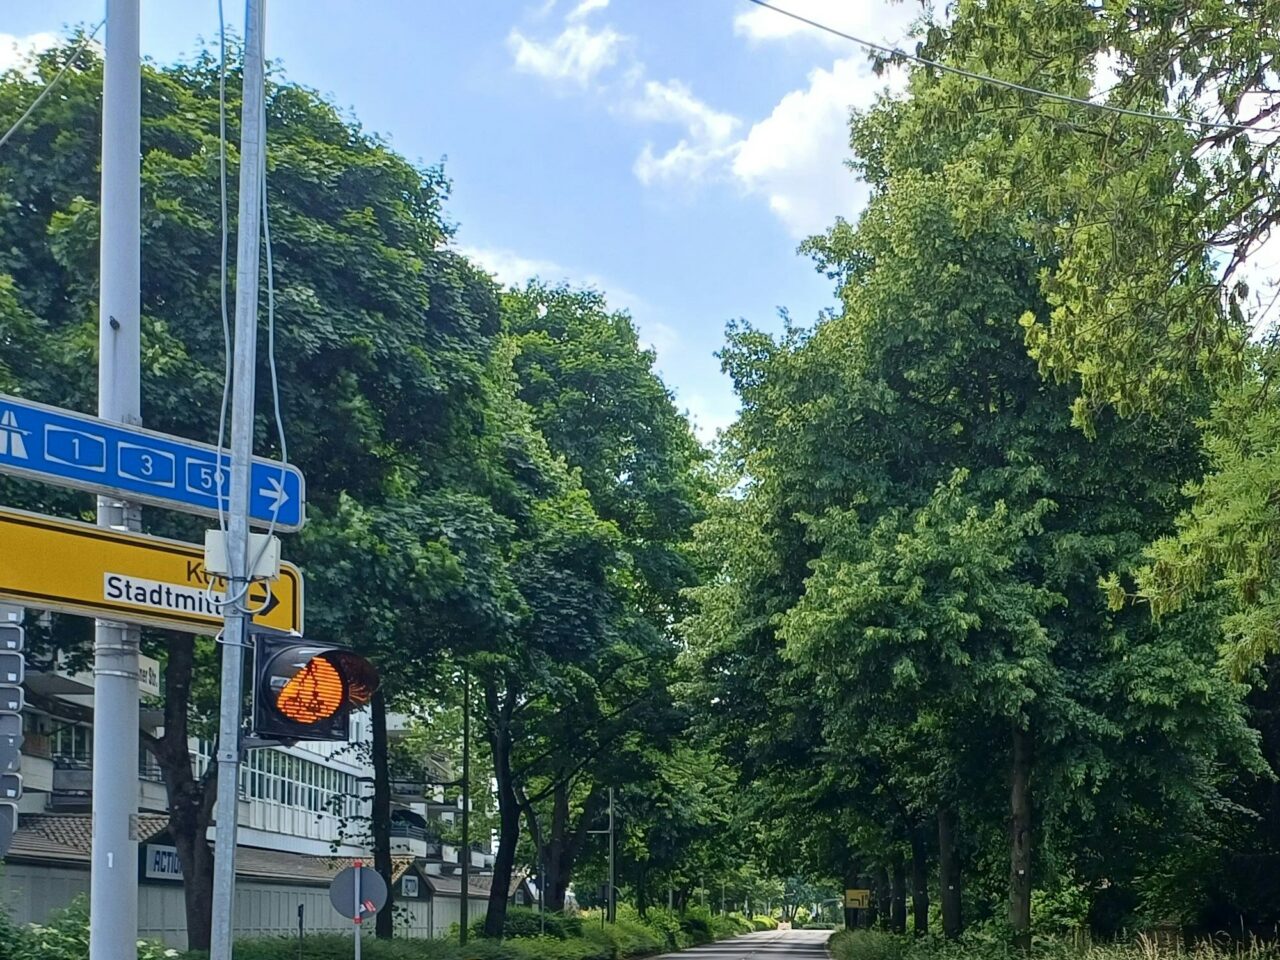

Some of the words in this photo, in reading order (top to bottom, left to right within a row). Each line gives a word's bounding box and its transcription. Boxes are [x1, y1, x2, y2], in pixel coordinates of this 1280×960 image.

[72, 438, 79, 460] 1
[141, 454, 152, 476] 3
[107, 576, 222, 615] Stadtmitt
